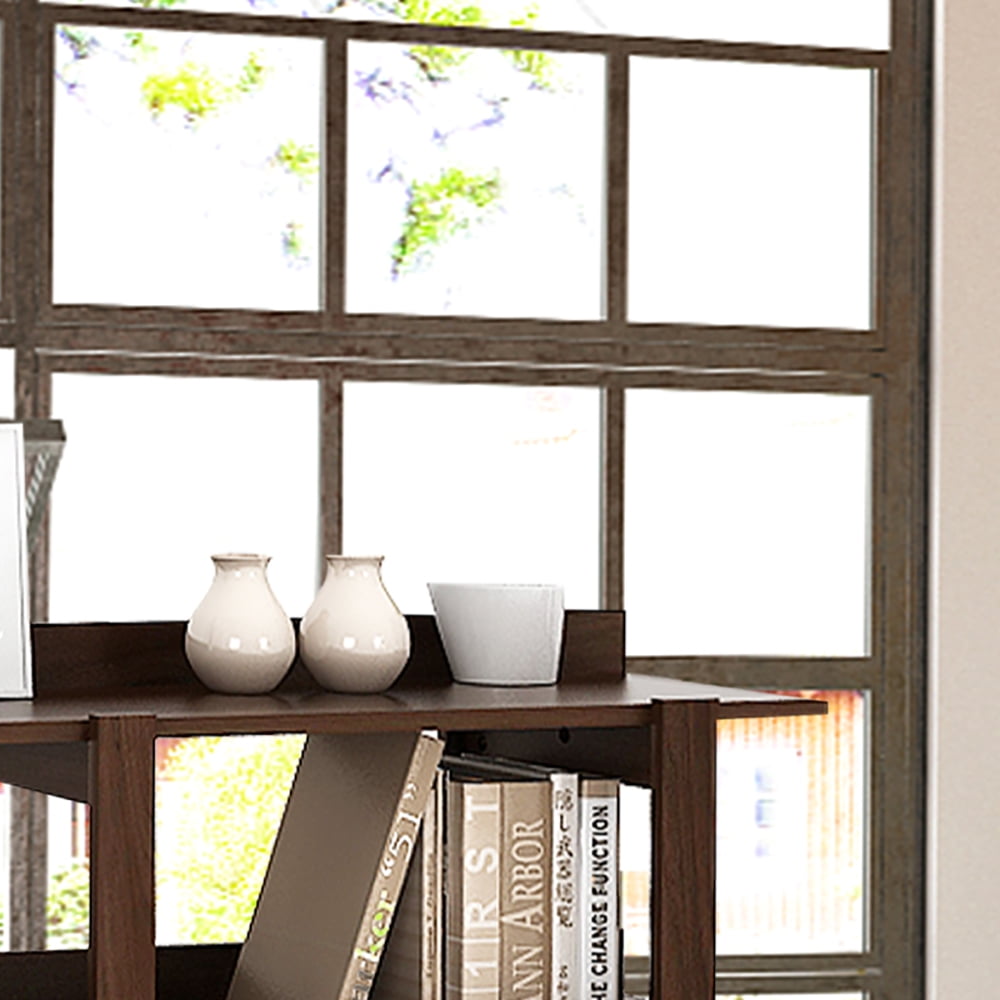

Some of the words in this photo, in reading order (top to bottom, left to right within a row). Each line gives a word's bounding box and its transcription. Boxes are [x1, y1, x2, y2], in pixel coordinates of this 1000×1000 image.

[500, 818, 544, 934] ARBOR
[591, 804, 609, 897] FUNCTION
[591, 901, 609, 977] CHANGE
